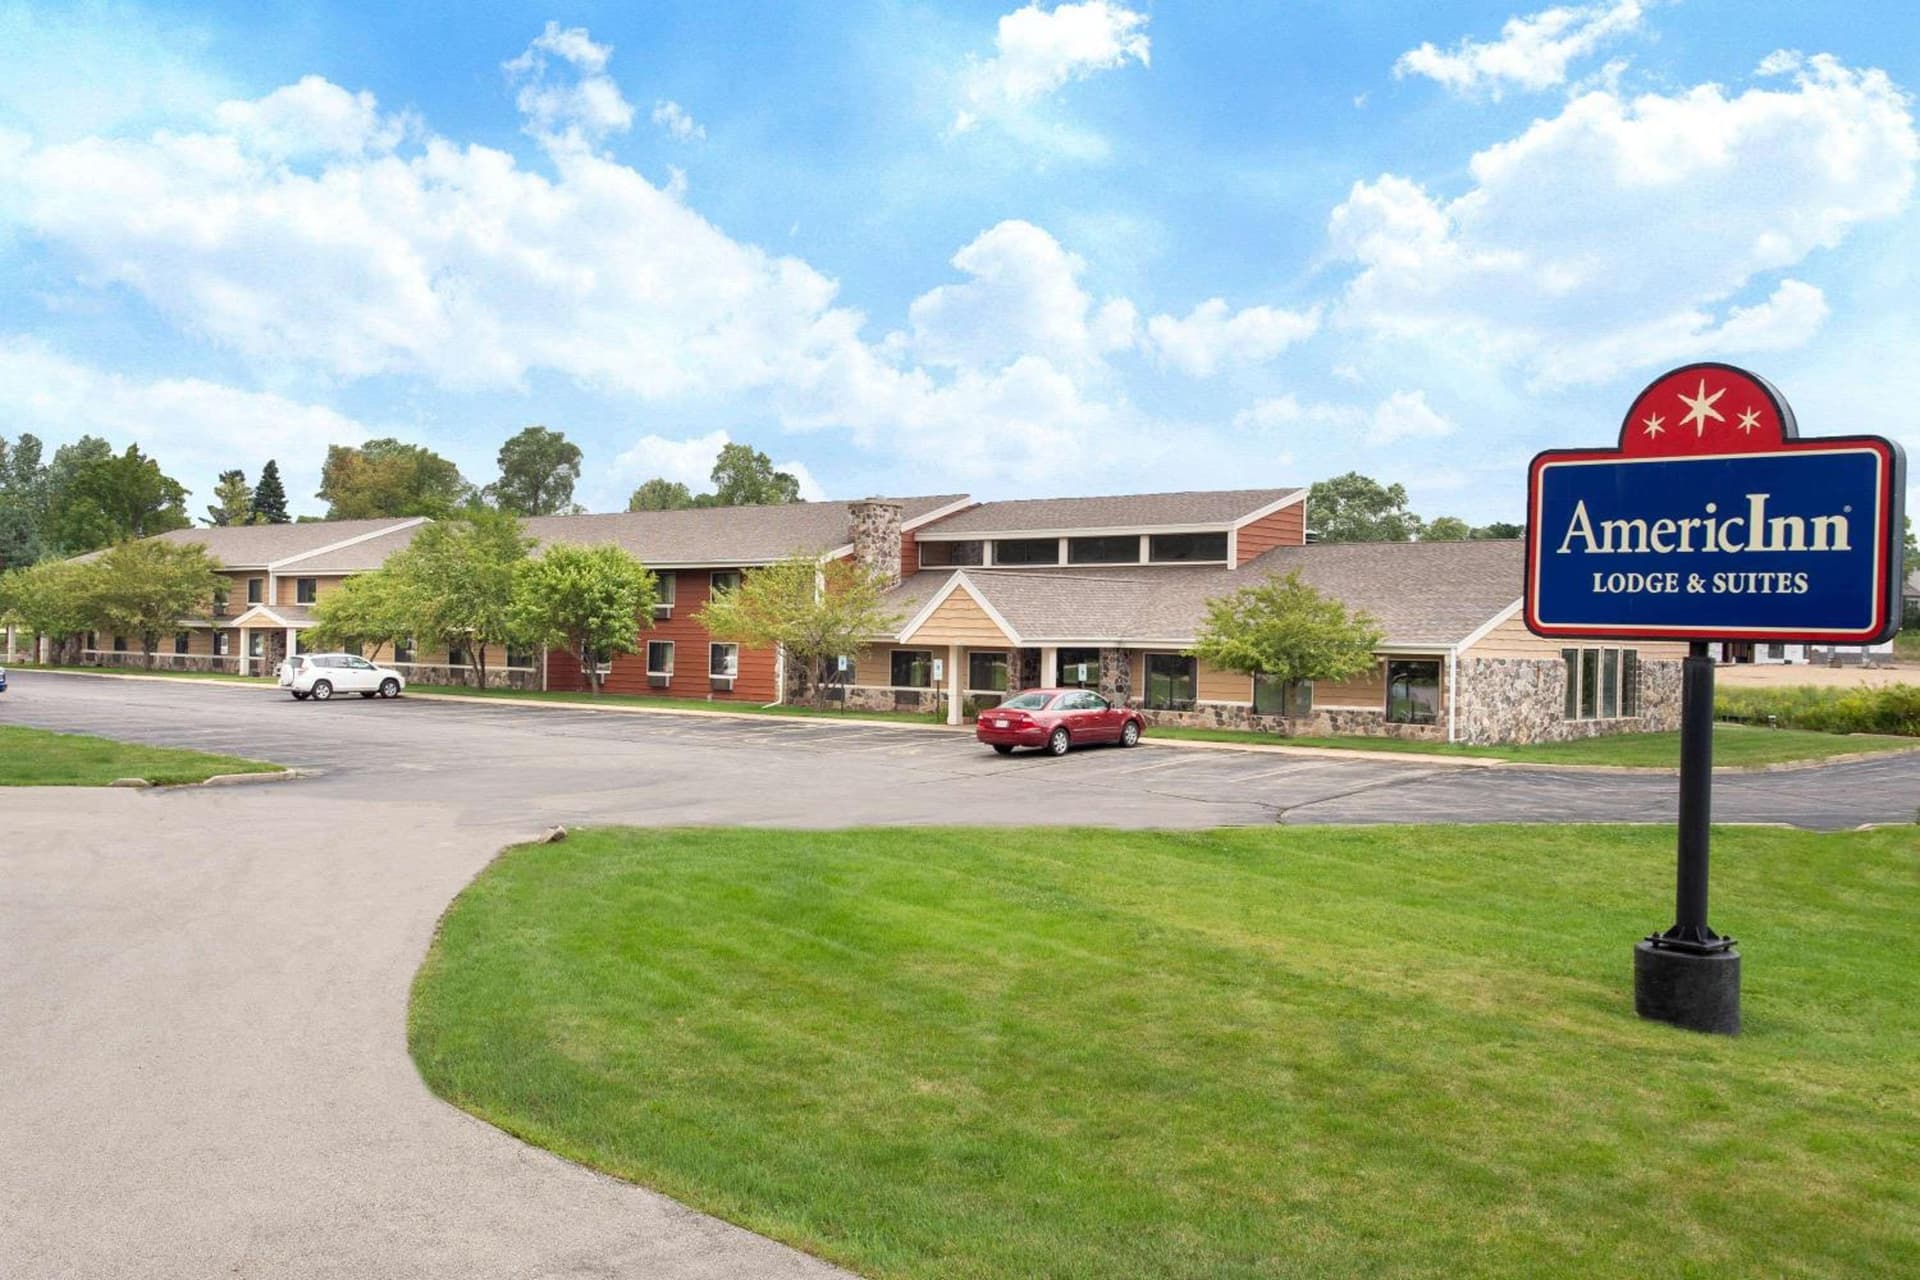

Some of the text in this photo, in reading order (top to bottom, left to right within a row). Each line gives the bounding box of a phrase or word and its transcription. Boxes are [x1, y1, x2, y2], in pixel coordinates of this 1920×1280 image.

[1556, 493, 1852, 554] AmericInn
[1592, 572, 1808, 594] LODGE & SUITES
